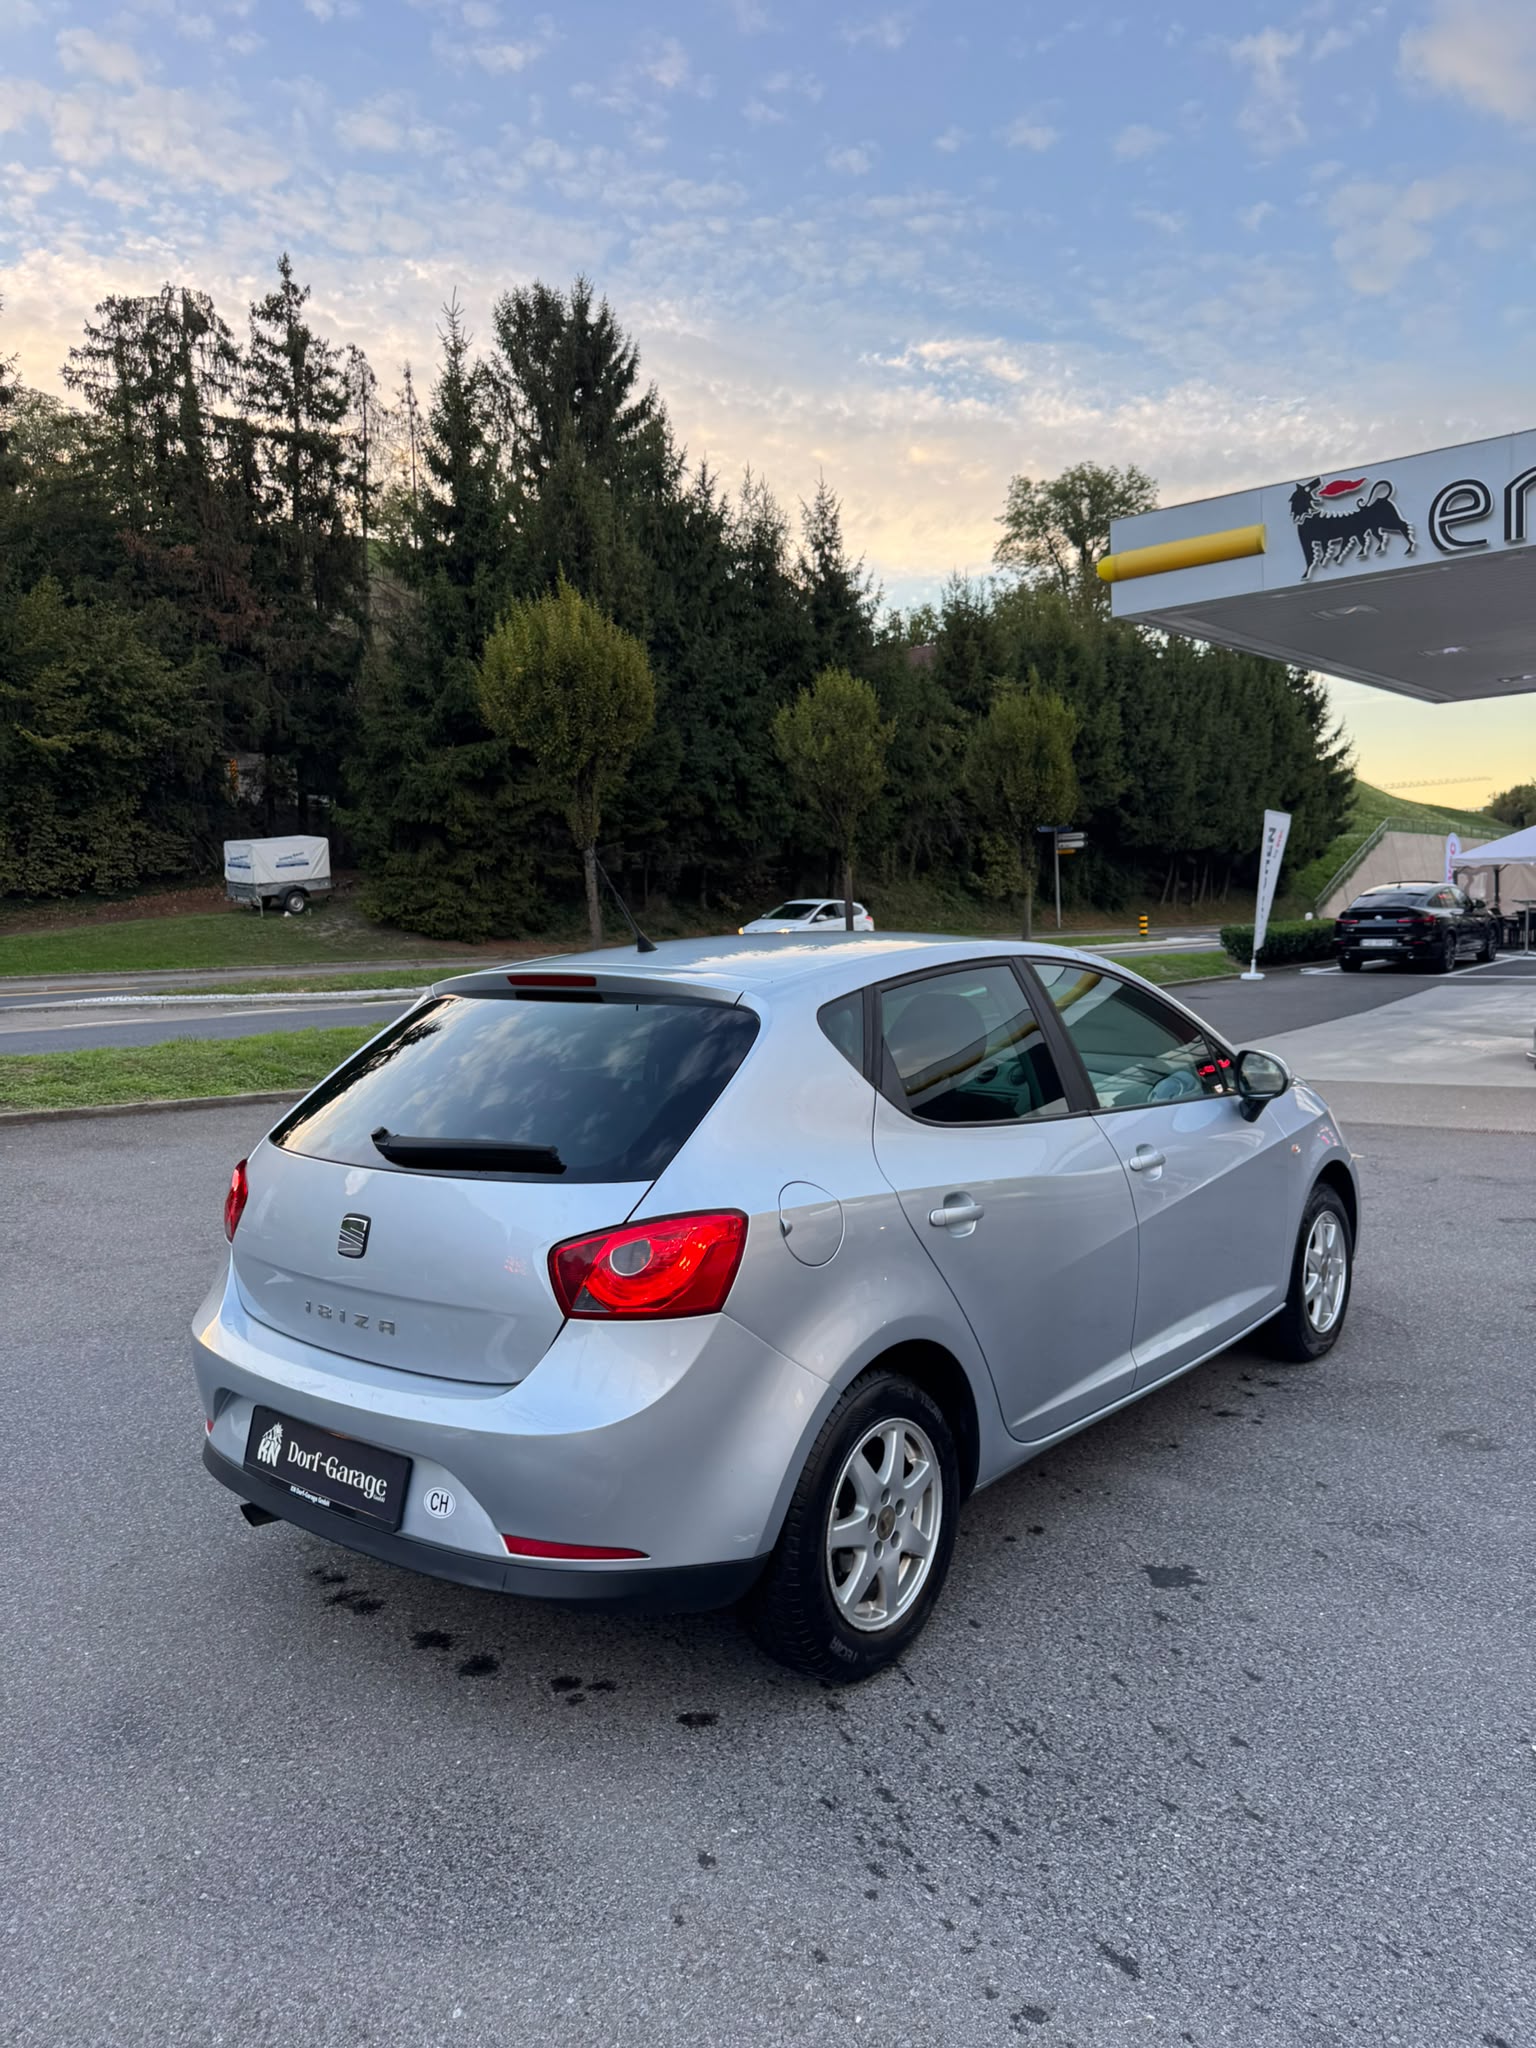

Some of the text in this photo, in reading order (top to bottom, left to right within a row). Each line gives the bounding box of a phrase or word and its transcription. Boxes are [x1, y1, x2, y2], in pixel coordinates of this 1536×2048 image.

[305, 1300, 396, 1336] IBIZA
[287, 1441, 387, 1499] Dorf-Garage
[430, 1492, 449, 1513] CH
